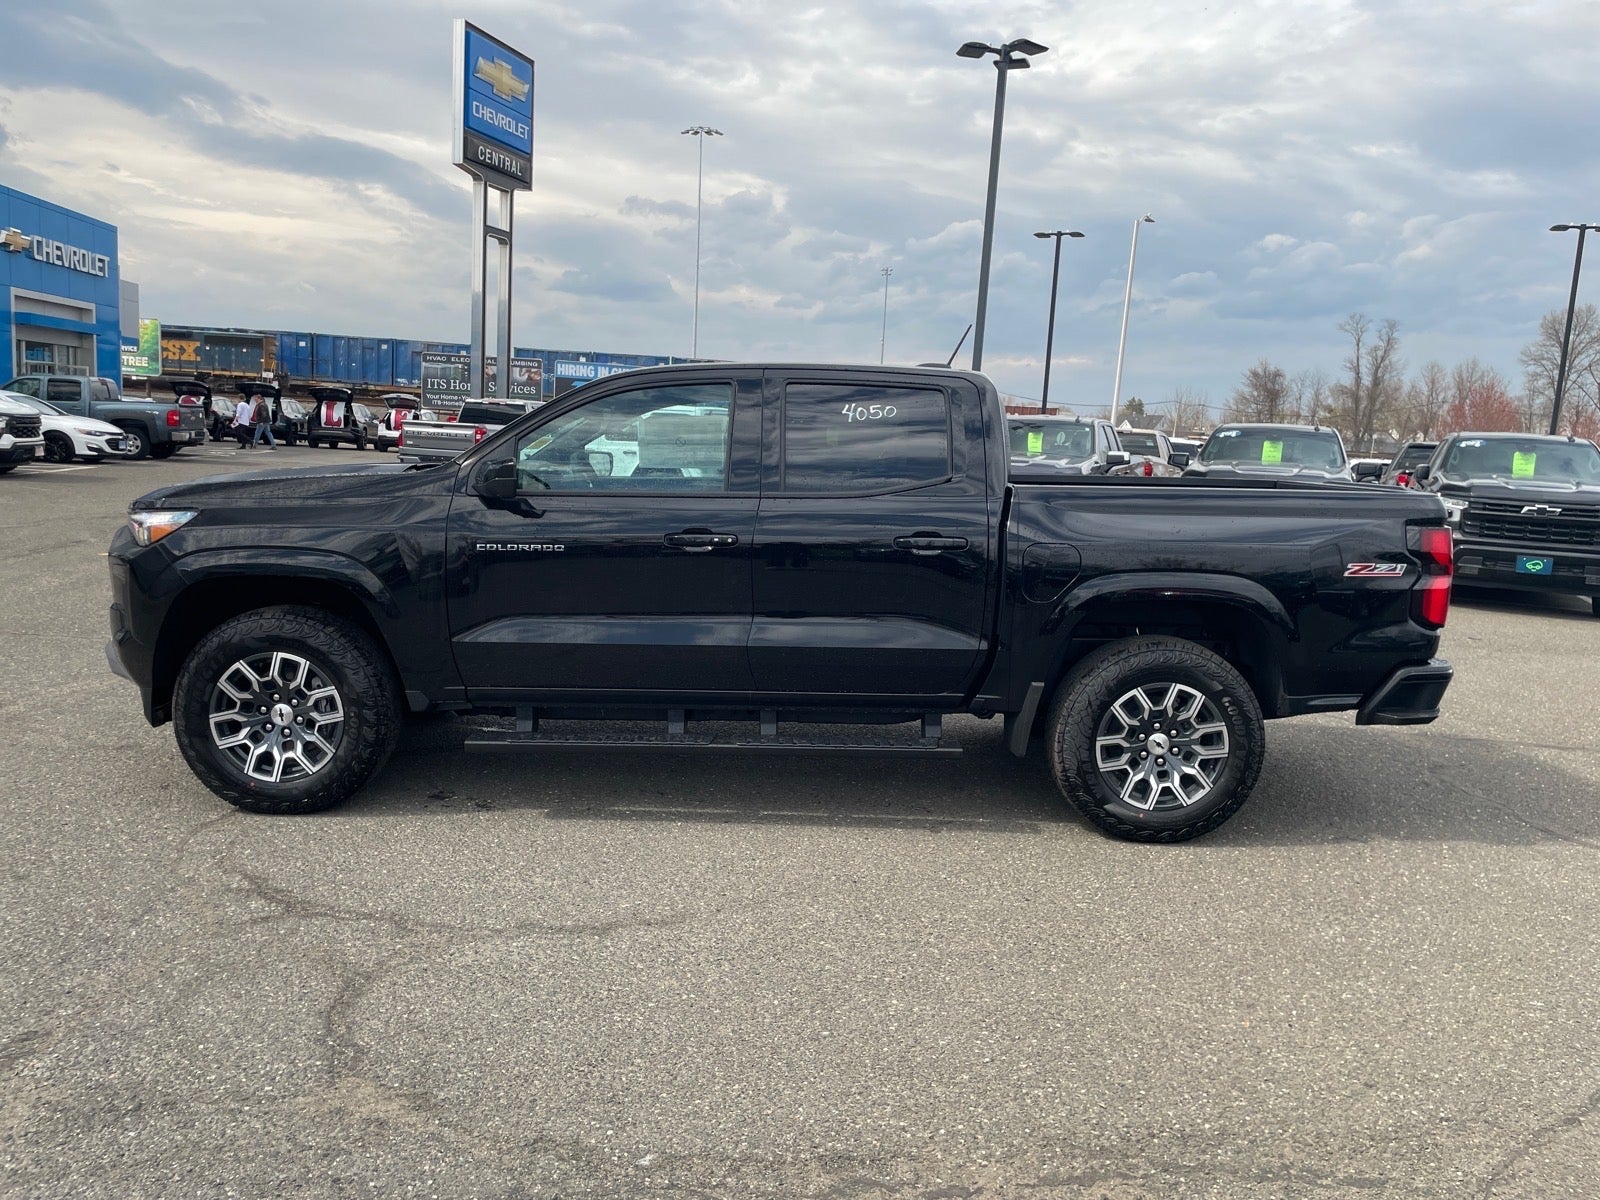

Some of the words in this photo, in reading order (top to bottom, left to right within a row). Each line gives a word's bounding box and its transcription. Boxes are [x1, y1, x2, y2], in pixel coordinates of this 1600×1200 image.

[473, 101, 529, 140] CHEVROLET
[478, 145, 522, 176] CENTRAL
[33, 236, 110, 277] CHEVROLET
[557, 363, 595, 377] HIRING
[427, 378, 447, 390] ITS
[841, 403, 897, 423] 4050
[476, 543, 565, 552] COLORADO
[1343, 562, 1407, 577] Z71
